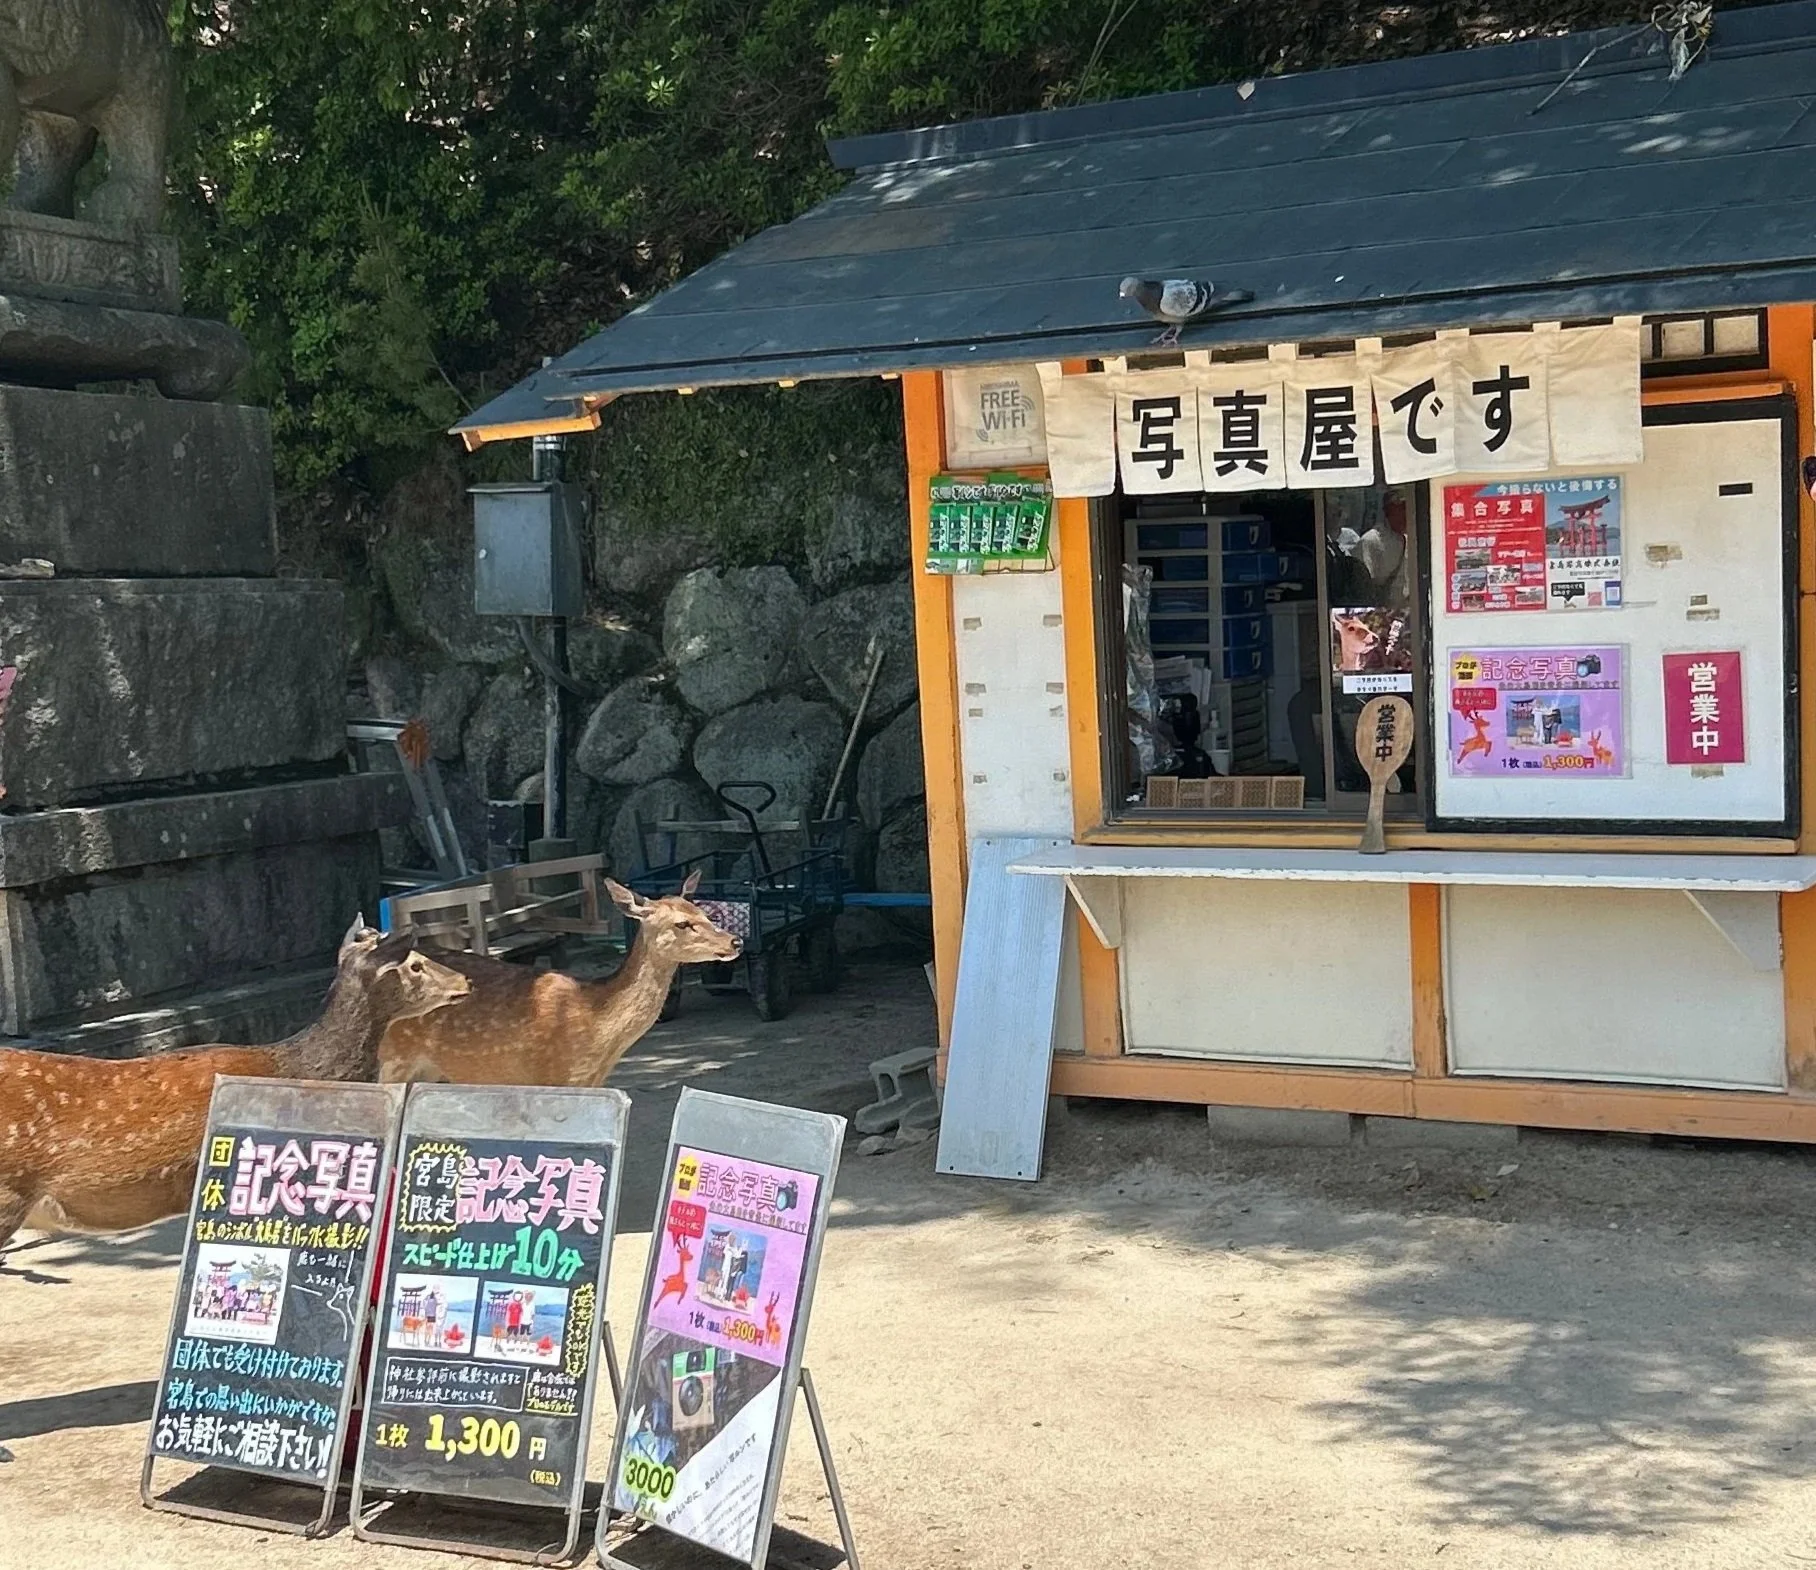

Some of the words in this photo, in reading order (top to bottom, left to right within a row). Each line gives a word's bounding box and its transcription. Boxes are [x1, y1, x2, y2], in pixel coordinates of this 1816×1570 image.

[981, 390, 1020, 409] FREE
[1132, 365, 1529, 479] 写真屋です
[1451, 499, 1533, 518] 集合写真
[1497, 478, 1618, 495] 今撮らないと後悔する
[1481, 655, 1578, 681] 記念写真
[1375, 704, 1396, 762] 営業中
[1688, 662, 1720, 756] 営業中
[1501, 757, 1520, 768] 1枚
[1543, 755, 1594, 770] 1,300円
[229, 1136, 378, 1224] 記念写真
[414, 1152, 460, 1190] 宮島
[456, 1154, 606, 1235] 記念写真
[697, 1163, 780, 1213] 記念写真
[409, 1194, 456, 1223] 限定
[403, 1225, 585, 1281] スピード仕上げ10分
[689, 1311, 706, 1329] 1枚
[722, 1315, 764, 1346] 1,300円
[172, 1338, 345, 1388] 団体でも受け付けております。
[167, 1377, 337, 1430] 宮島での思い出にいかがですか。
[376, 1423, 410, 1449] 1枚
[425, 1413, 521, 1461] 1,300
[528, 1436, 547, 1461] 円
[626, 1458, 675, 1499] 3000
